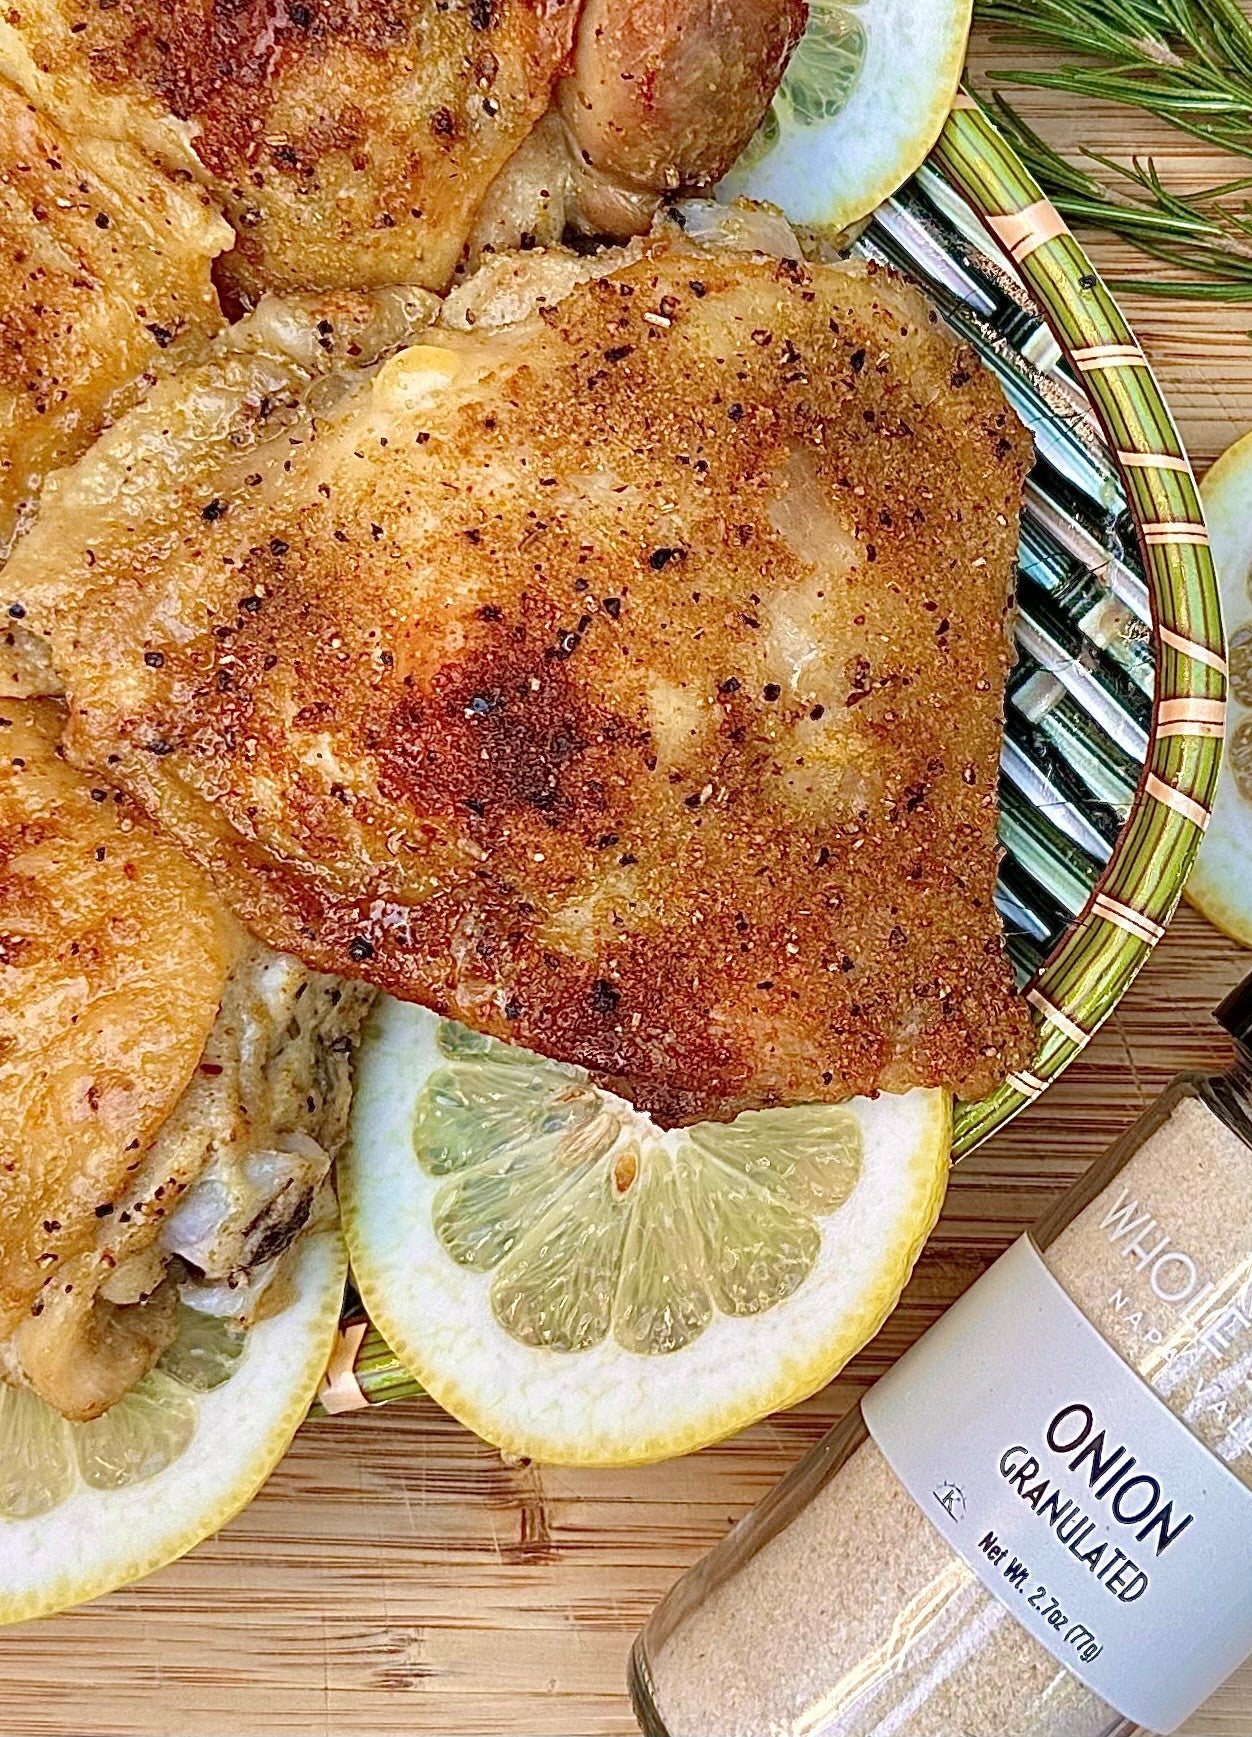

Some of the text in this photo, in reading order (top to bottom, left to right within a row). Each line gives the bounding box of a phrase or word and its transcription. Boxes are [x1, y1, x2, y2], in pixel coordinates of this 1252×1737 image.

[1099, 1187, 1252, 1358] WHOLE
[1000, 1445, 1149, 1603] GRANULATED
[1046, 1403, 1194, 1557] ONION
[977, 1530, 1104, 1664] Net Wt. 2.7oz (77g)
